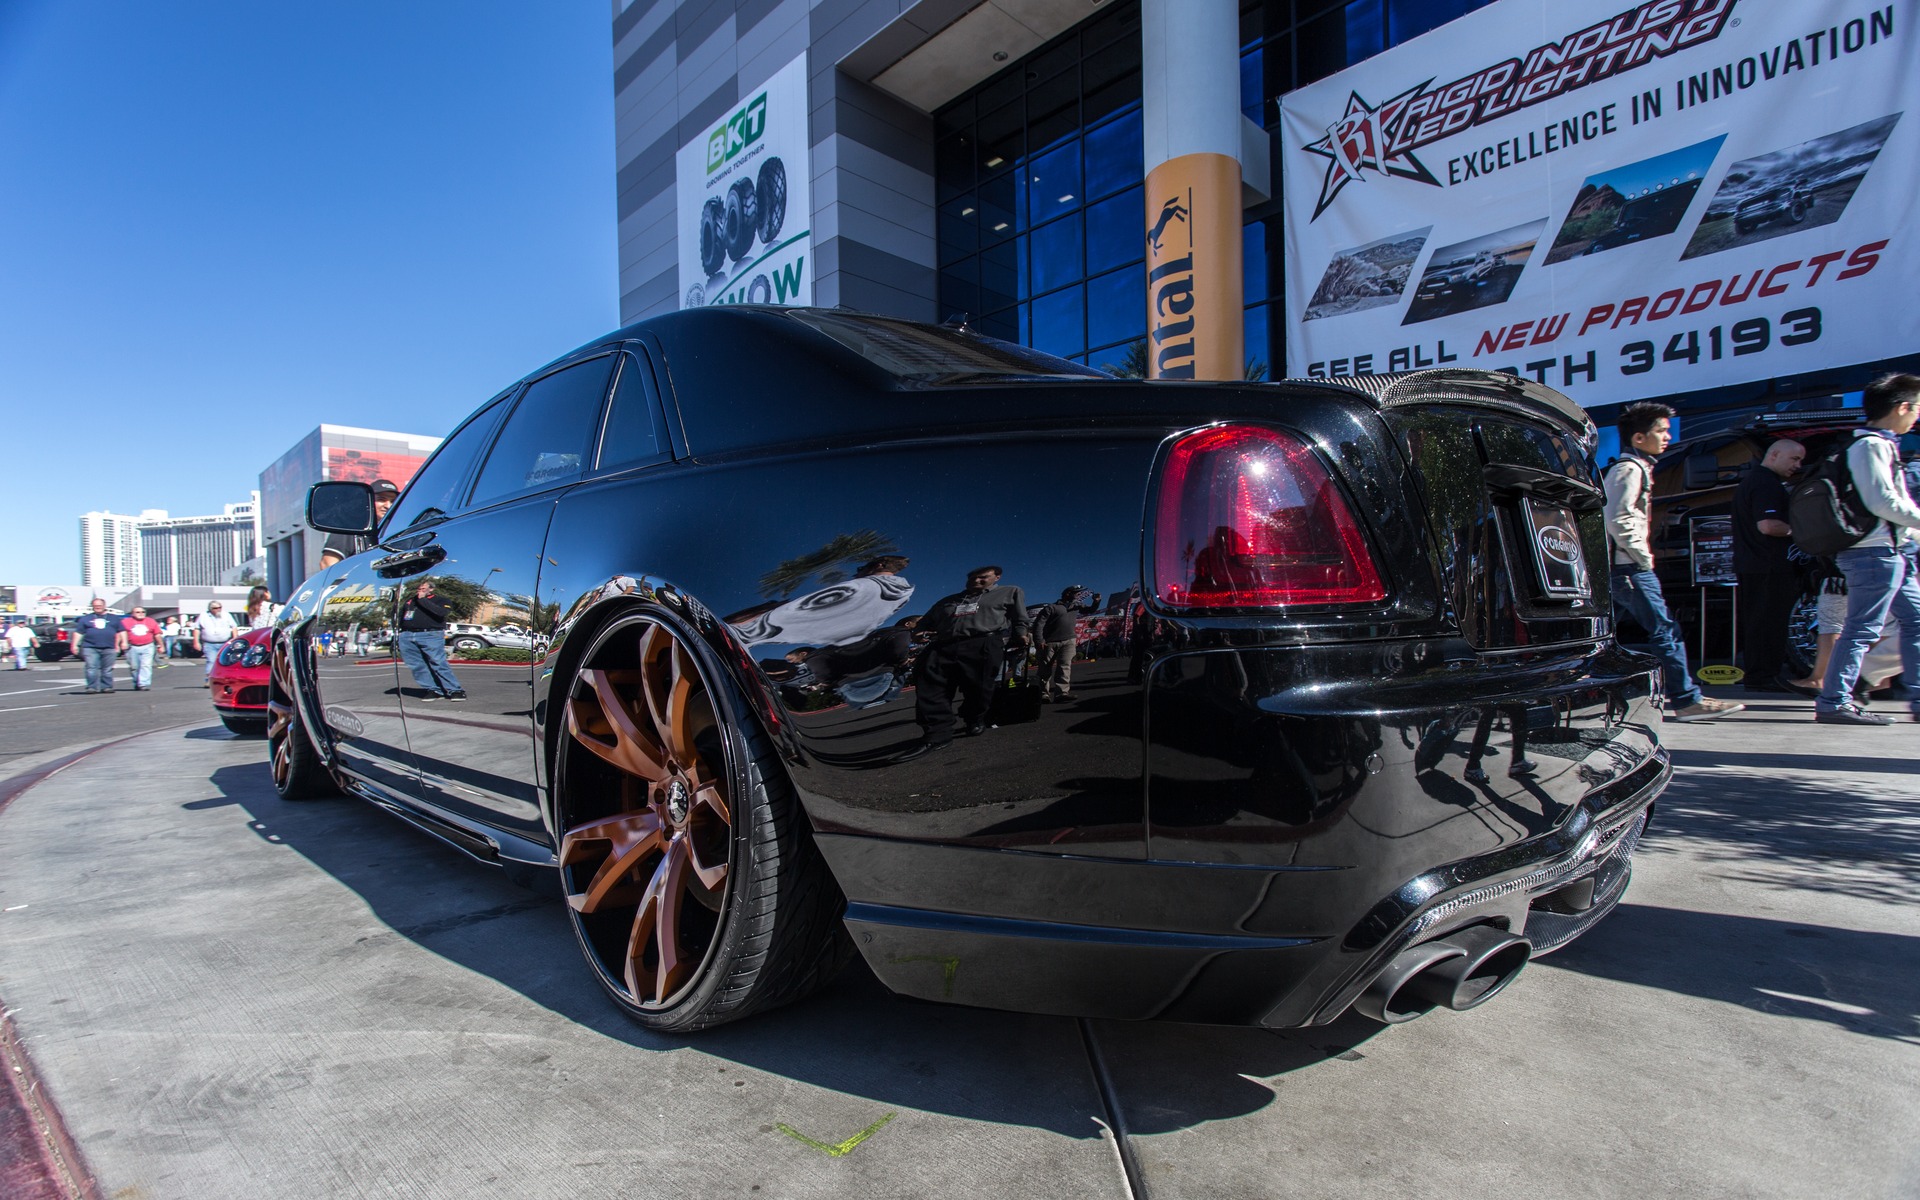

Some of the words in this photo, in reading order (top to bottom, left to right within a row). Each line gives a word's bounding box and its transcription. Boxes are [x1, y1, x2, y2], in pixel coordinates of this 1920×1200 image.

[1387, 101, 1478, 152] LED
[1479, 5, 1726, 119] LIGHTING
[1402, 59, 1520, 119] RIGID
[1448, 103, 1617, 186] EXCELLENCE
[1631, 87, 1662, 126] IN
[1676, 4, 1894, 111] INNOVATION
[706, 167, 732, 189] GROWING
[733, 143, 765, 170] TOGETHER
[707, 92, 767, 175] BKT
[1308, 354, 1374, 379] SEE
[1389, 340, 1458, 371] ALL
[1473, 313, 1571, 357] NEW
[1578, 239, 1891, 336] PRODUCTS
[1496, 350, 1597, 387] TH
[1620, 306, 1823, 376] 34193
